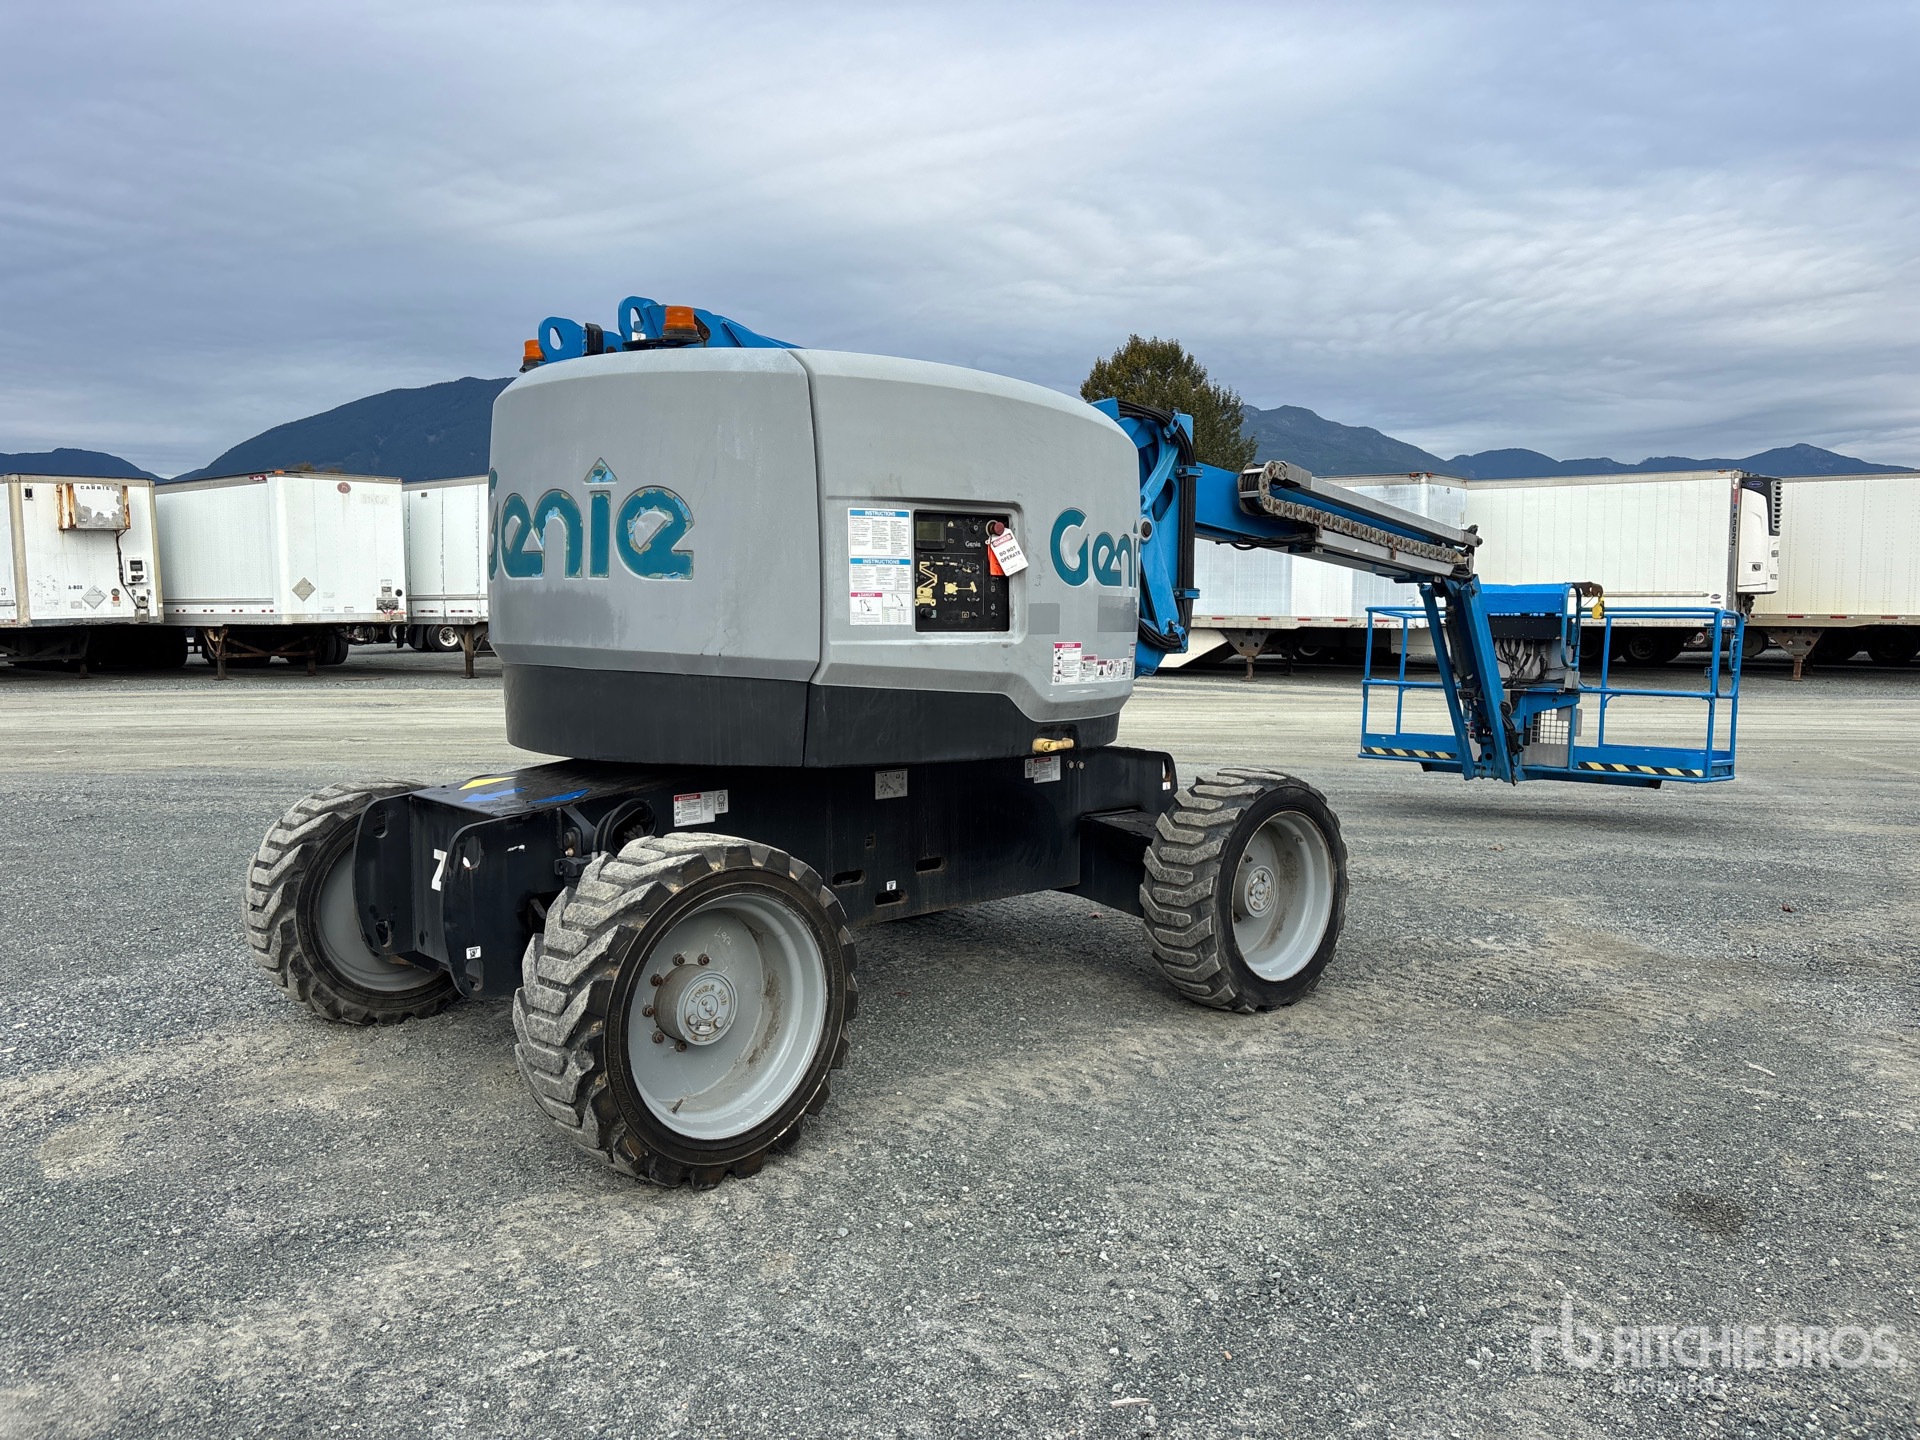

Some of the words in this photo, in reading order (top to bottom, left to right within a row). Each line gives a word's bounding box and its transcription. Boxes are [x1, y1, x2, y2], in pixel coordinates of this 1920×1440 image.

[489, 457, 695, 581] enie
[965, 540, 981, 548] Genie
[1006, 545, 1017, 553] NOT
[1049, 508, 1141, 588] Geni
[1000, 550, 1021, 563] OPERATE
